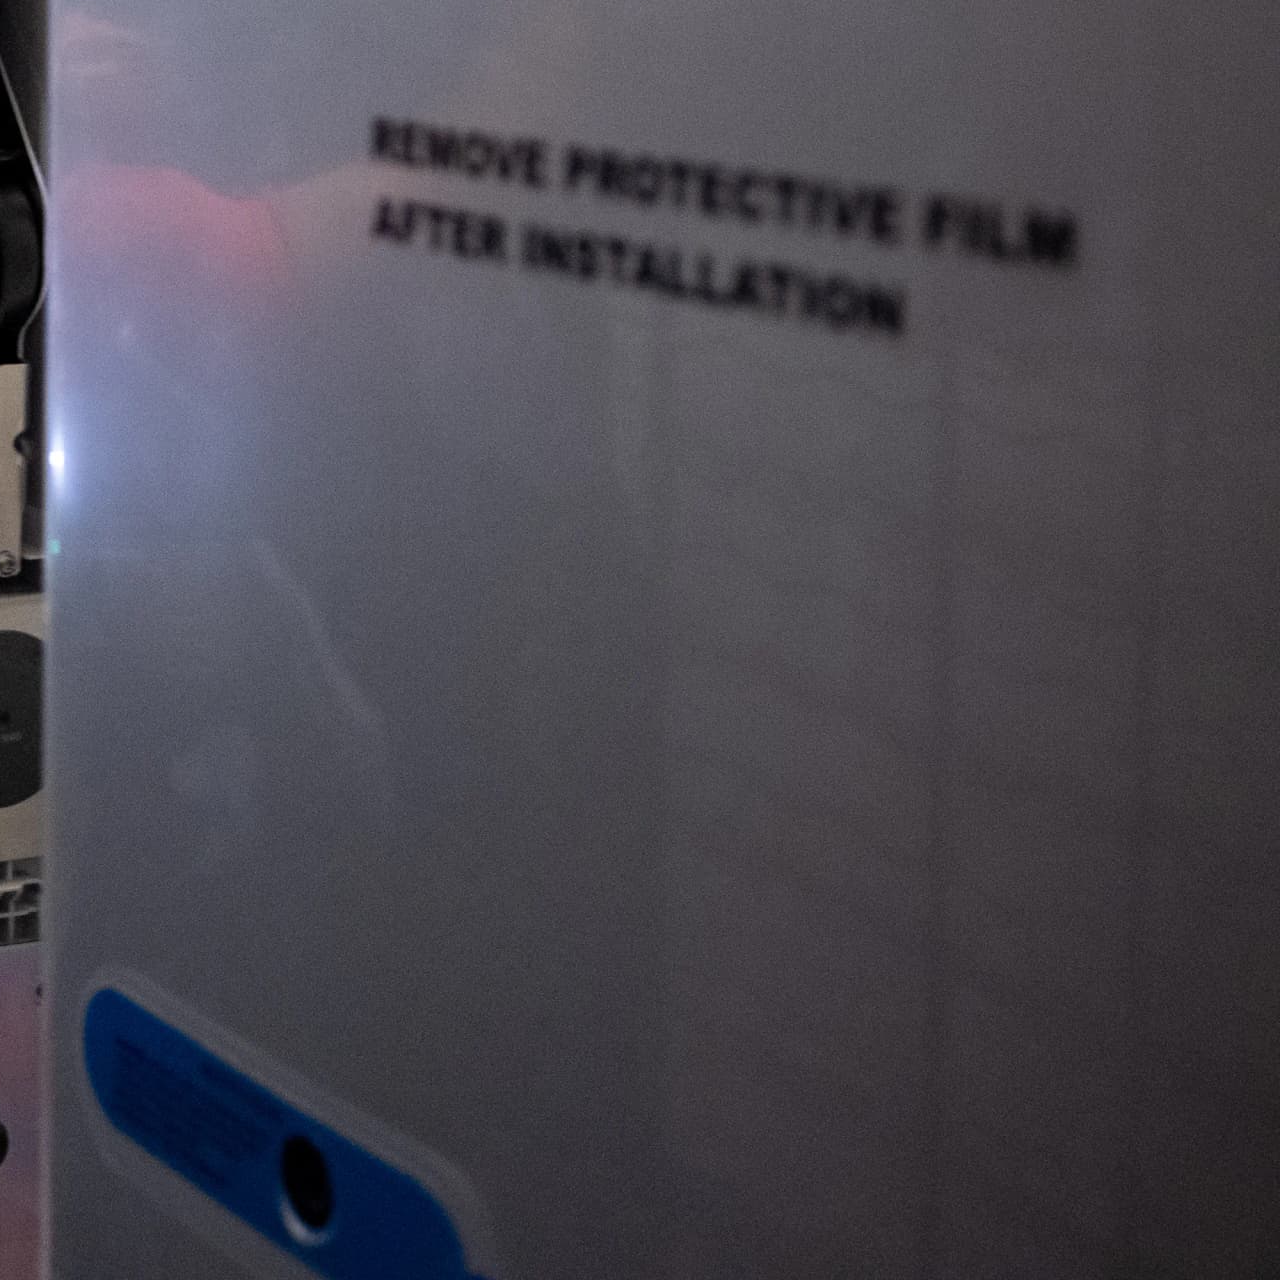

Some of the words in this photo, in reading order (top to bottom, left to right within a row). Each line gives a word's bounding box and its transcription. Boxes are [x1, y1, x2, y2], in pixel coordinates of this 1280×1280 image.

[371, 117, 546, 188] REMOVE
[565, 142, 899, 244] PROTECTIVE
[925, 192, 1078, 268] FILM
[371, 198, 506, 265] AFTER
[521, 223, 907, 336] INSTALLATION
